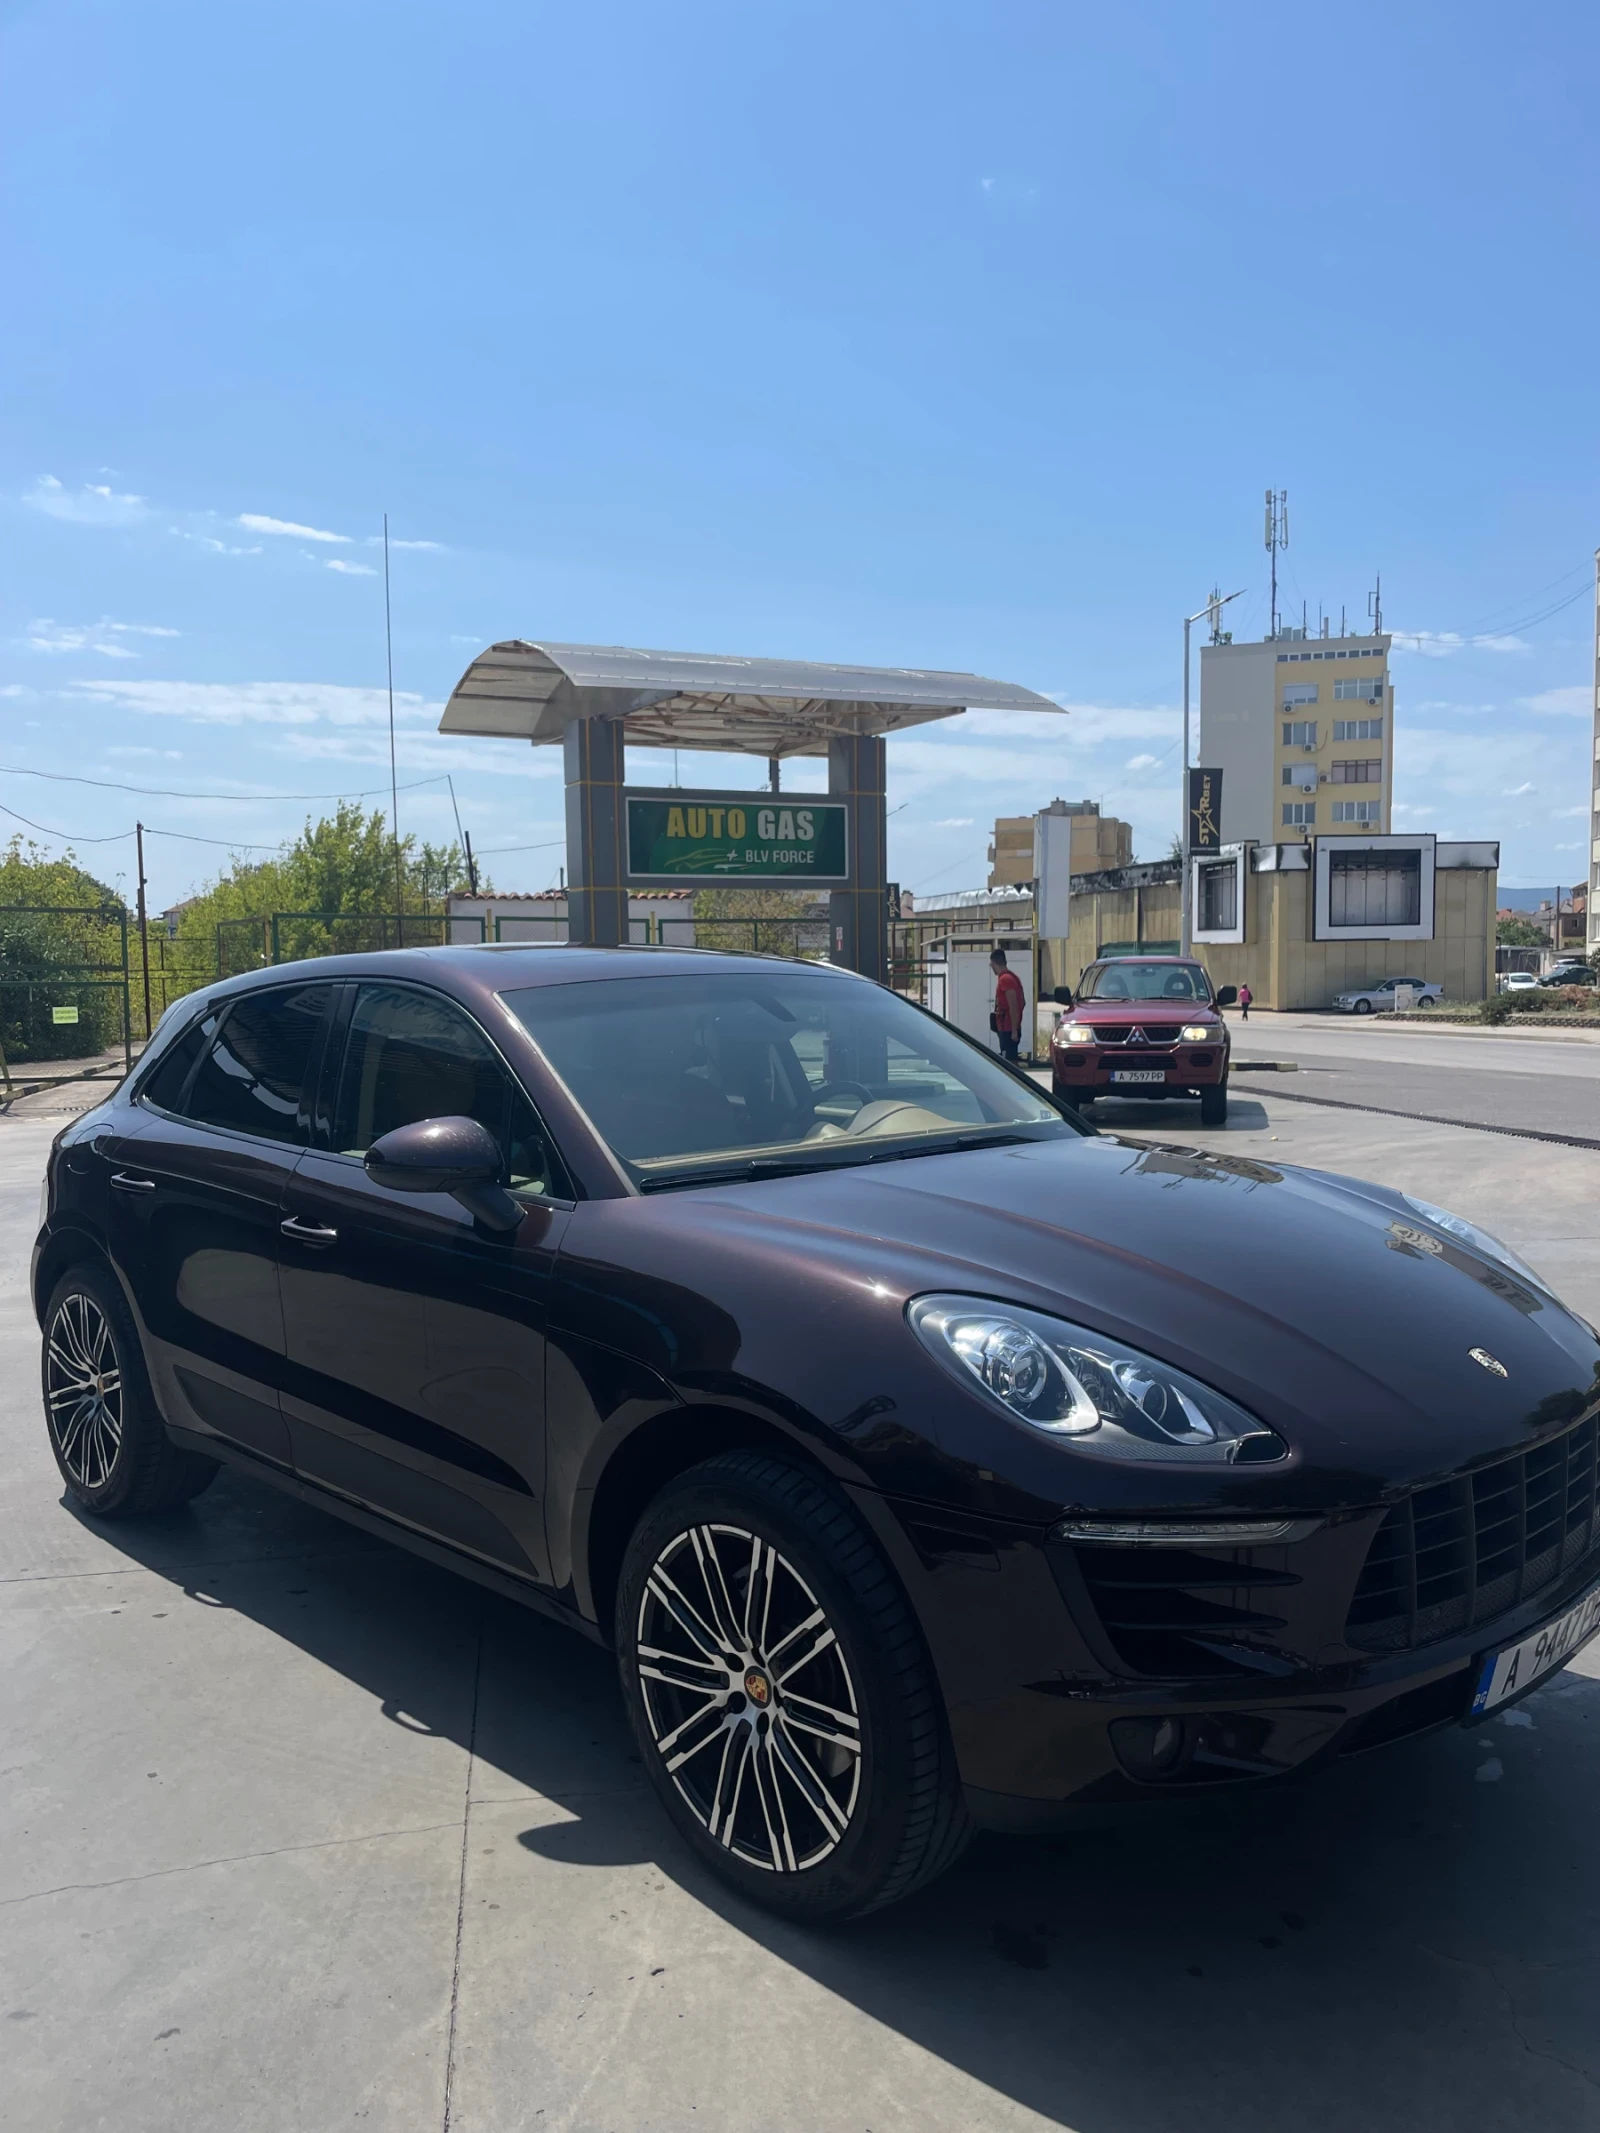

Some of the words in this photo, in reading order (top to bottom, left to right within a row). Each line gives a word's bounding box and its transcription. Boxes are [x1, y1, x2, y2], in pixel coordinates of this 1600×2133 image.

[666, 807, 746, 840] AUTO
[757, 809, 815, 841] GAS
[745, 850, 769, 863] BLV
[773, 850, 815, 864] FORCE
[1129, 1072, 1150, 1081] 7597
[1473, 1691, 1487, 1707] BG
[1501, 1649, 1521, 1695] A
[1532, 1603, 1585, 1676] 9447
